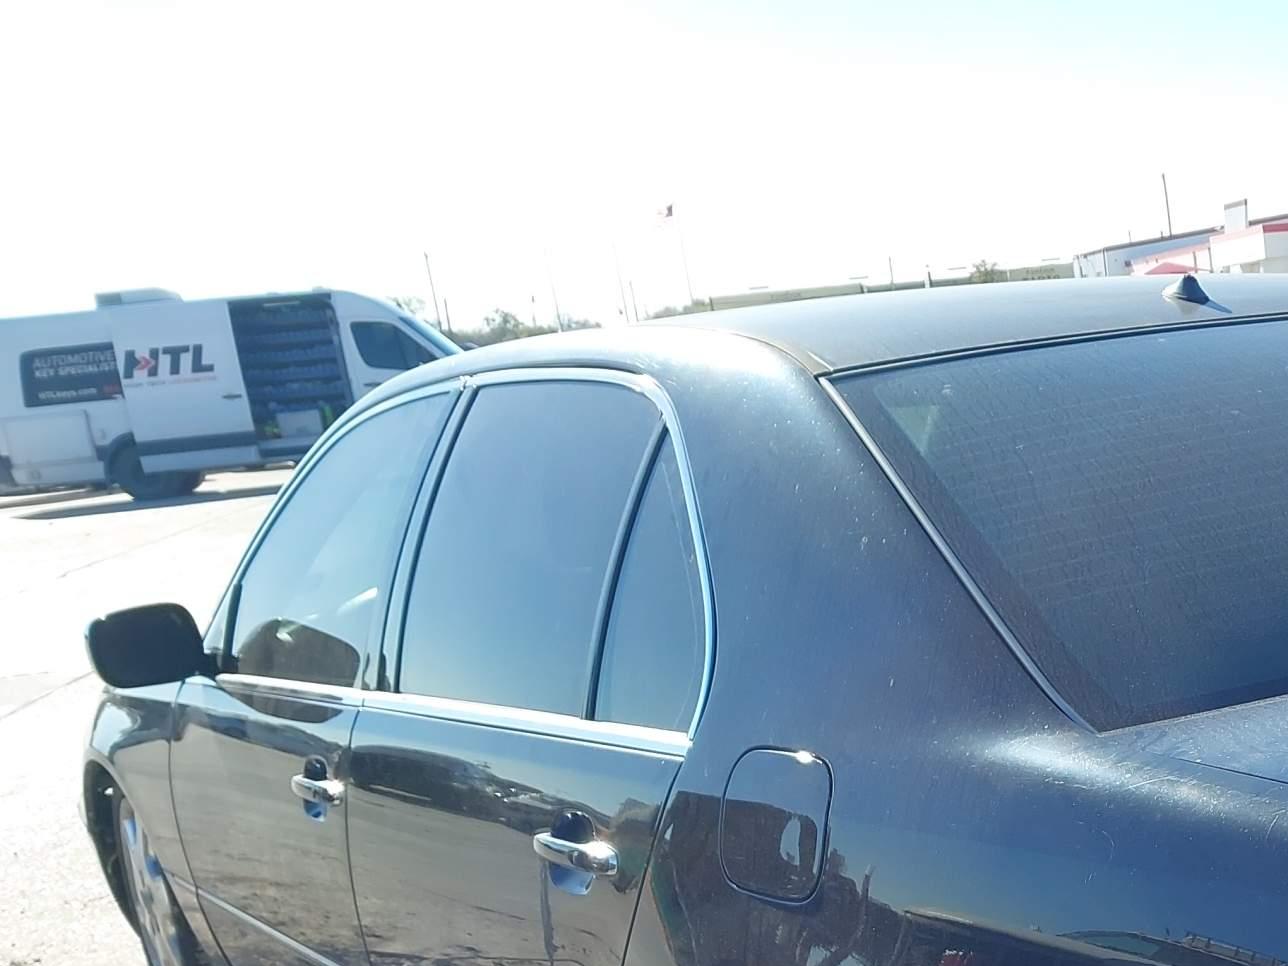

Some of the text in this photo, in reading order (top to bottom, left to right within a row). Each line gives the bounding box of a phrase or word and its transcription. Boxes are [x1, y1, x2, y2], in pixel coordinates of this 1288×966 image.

[32, 350, 116, 368] AUTOMOTIVE
[123, 344, 215, 379] HTL
[34, 367, 55, 378] KEY
